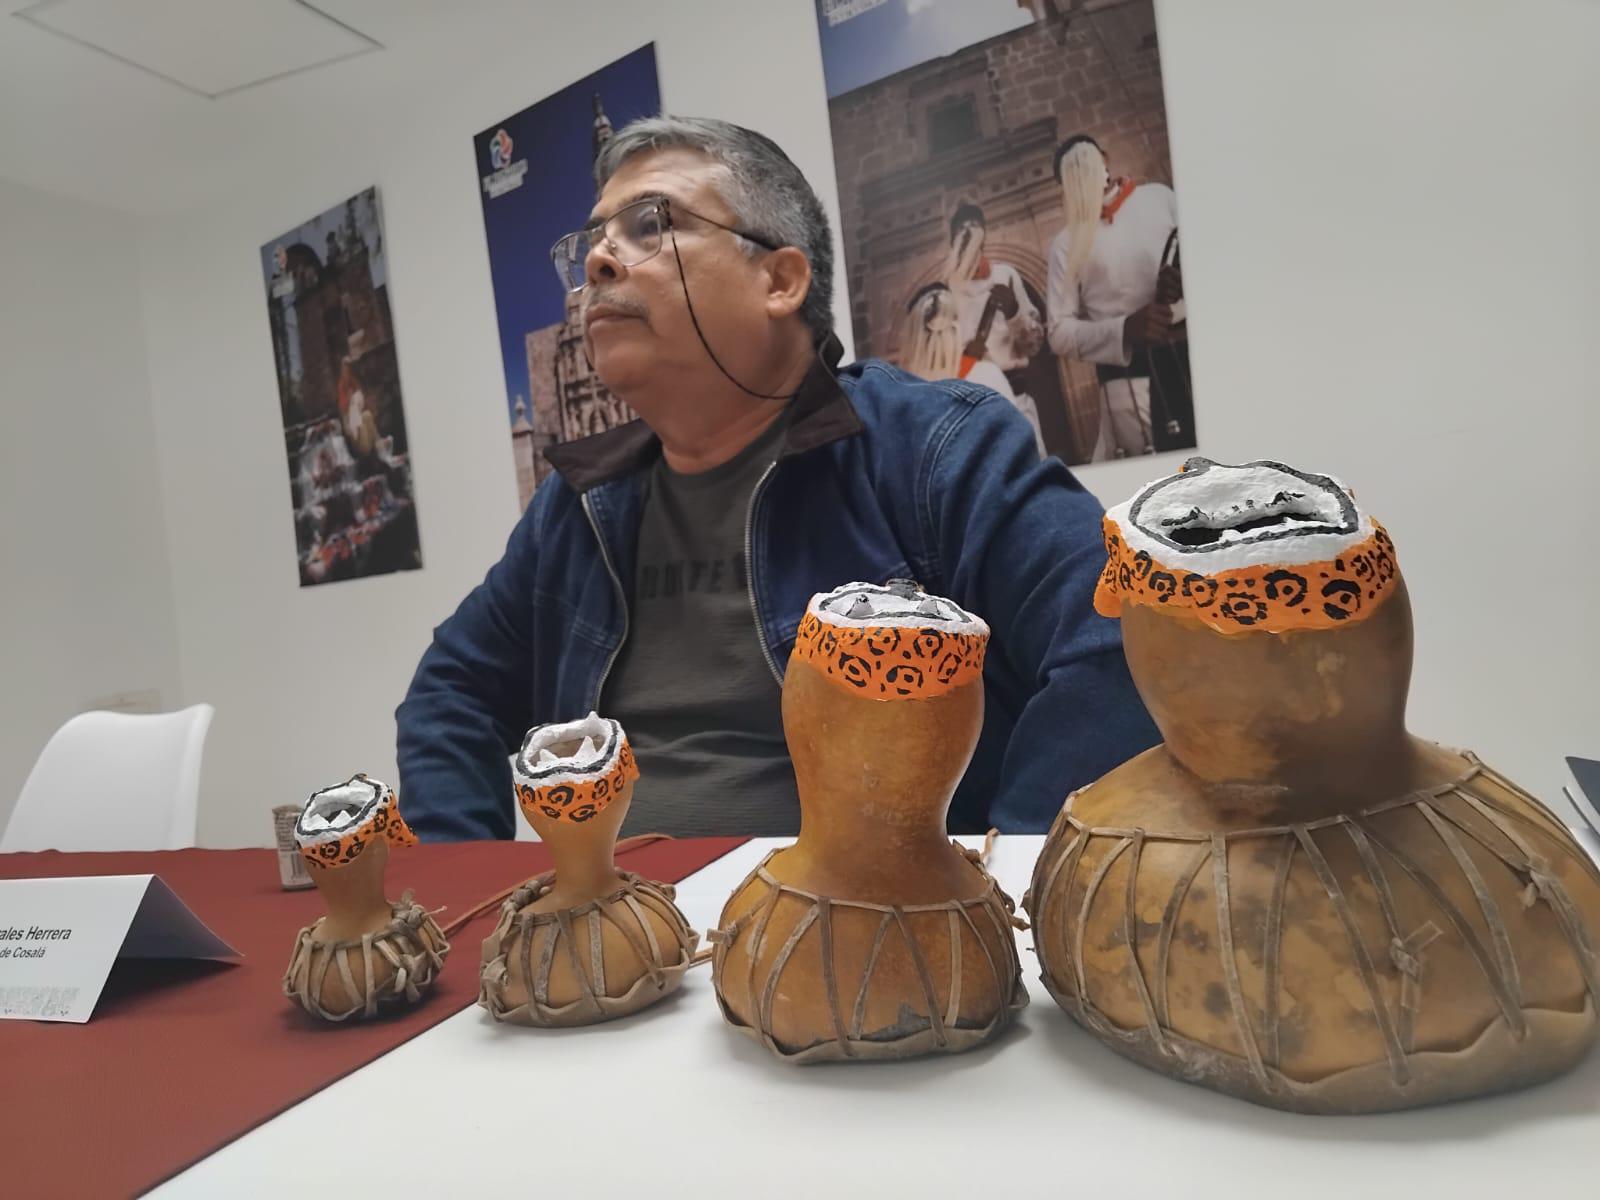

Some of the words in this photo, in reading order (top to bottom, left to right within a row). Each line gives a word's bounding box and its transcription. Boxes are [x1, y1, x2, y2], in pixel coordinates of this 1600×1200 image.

[0, 926, 25, 940] ales
[25, 925, 72, 940] Herrera
[0, 946, 12, 958] de
